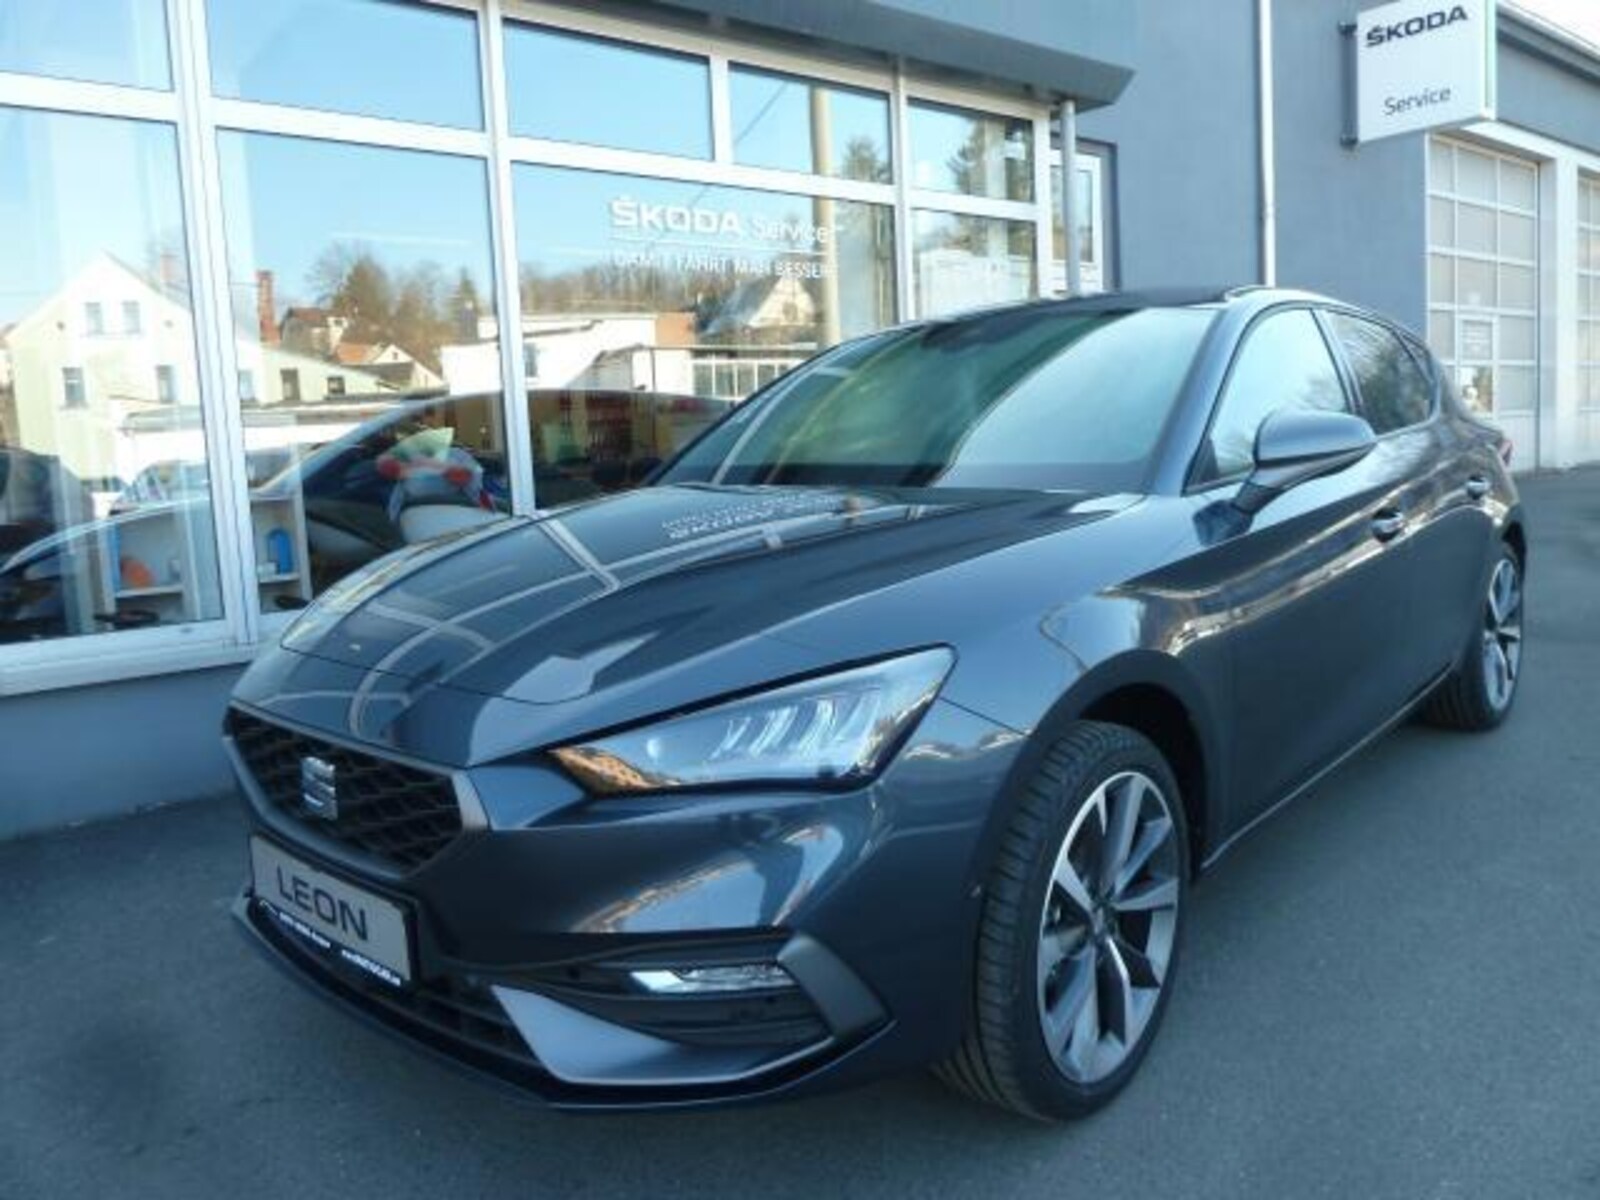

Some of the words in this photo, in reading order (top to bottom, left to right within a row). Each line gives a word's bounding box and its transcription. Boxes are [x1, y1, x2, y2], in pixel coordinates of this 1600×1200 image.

[1366, 5, 1469, 47] ŠKODA
[1383, 87, 1451, 116] Service
[610, 196, 742, 237] ŠKODA
[753, 217, 831, 244] Service
[276, 865, 368, 941] LEON
